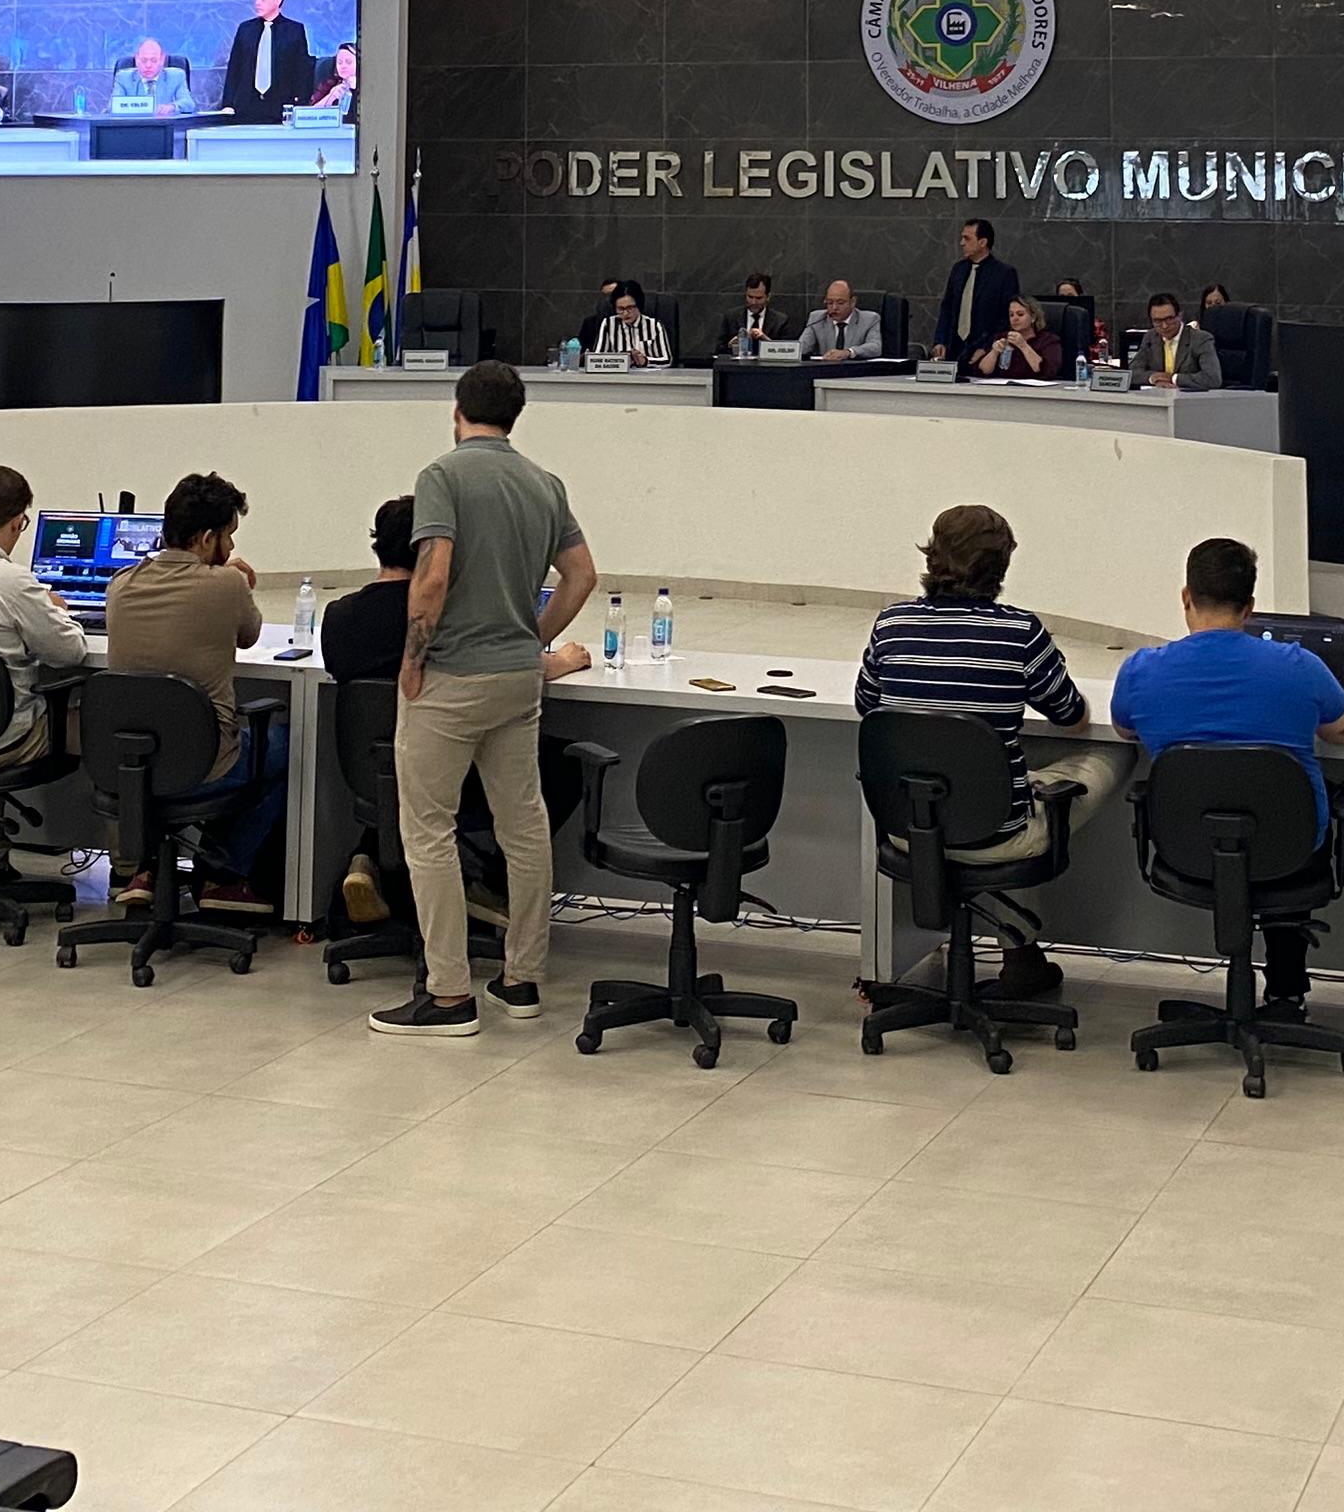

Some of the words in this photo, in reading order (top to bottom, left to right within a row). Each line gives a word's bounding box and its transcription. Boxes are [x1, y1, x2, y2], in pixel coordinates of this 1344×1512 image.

[871, 51, 881, 62] O
[875, 63, 913, 104] Vereador
[932, 76, 978, 90] VILHENA
[971, 95, 1009, 117] Cidade
[703, 149, 1100, 199] LEGISLATIVO
